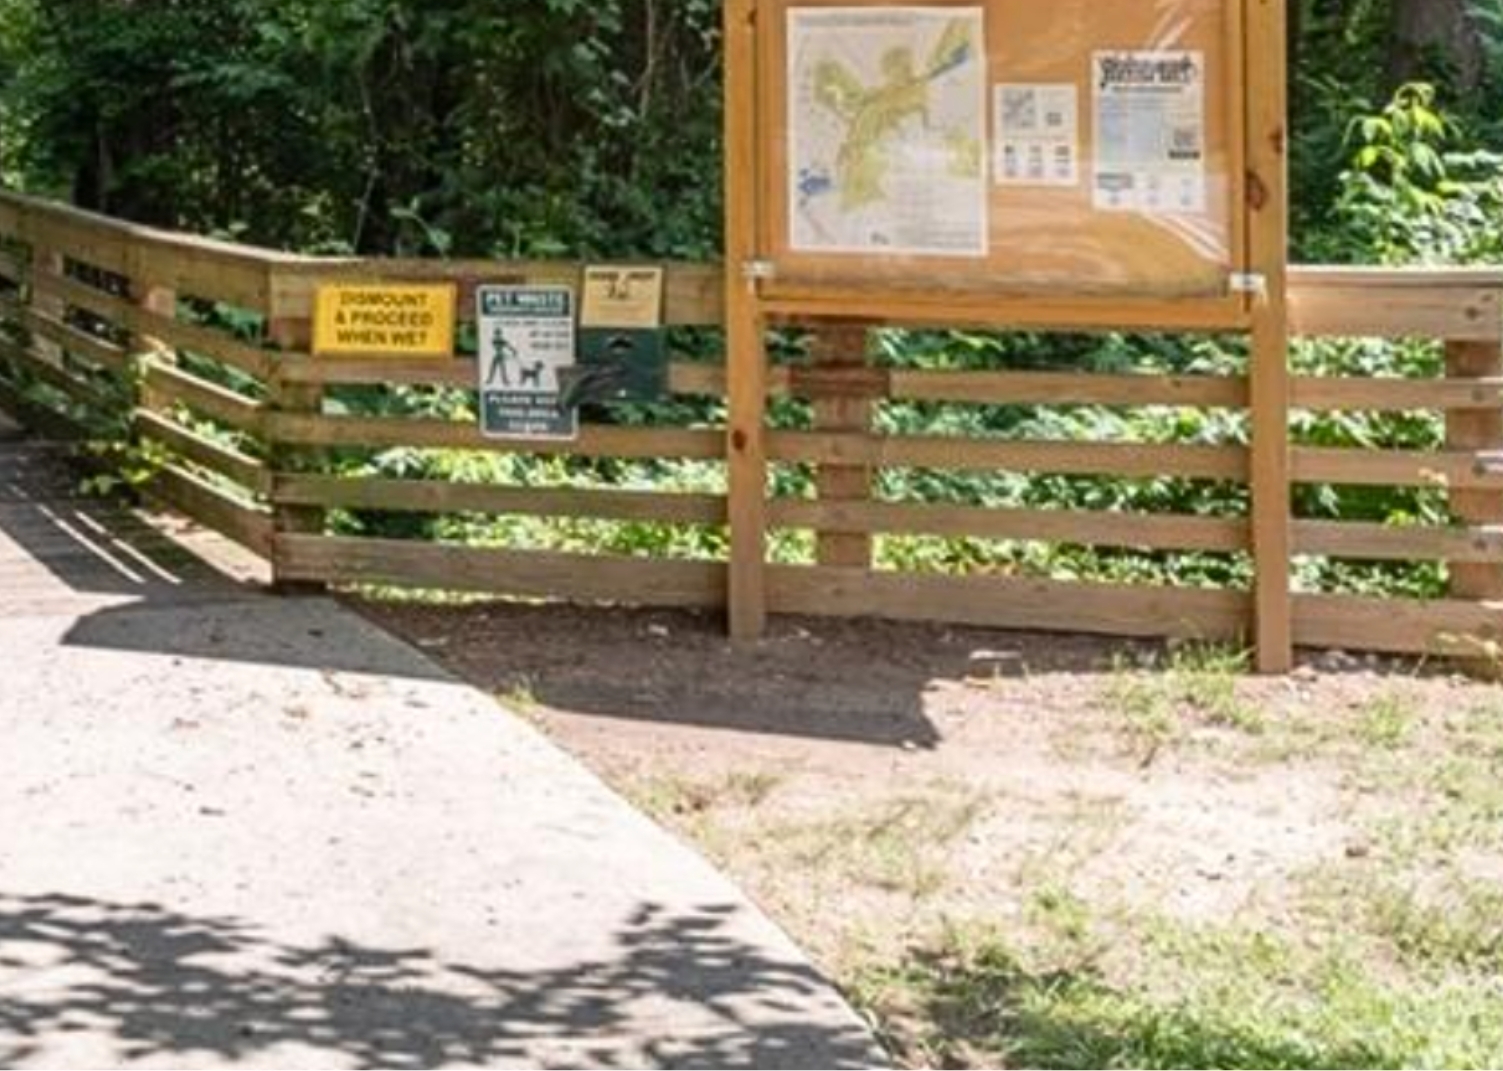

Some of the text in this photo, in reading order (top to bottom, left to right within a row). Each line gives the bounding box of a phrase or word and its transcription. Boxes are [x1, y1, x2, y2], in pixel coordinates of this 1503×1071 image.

[340, 291, 429, 307] DISMOUNT
[350, 310, 434, 327] PROCEED
[337, 330, 429, 346] WHEN WET
